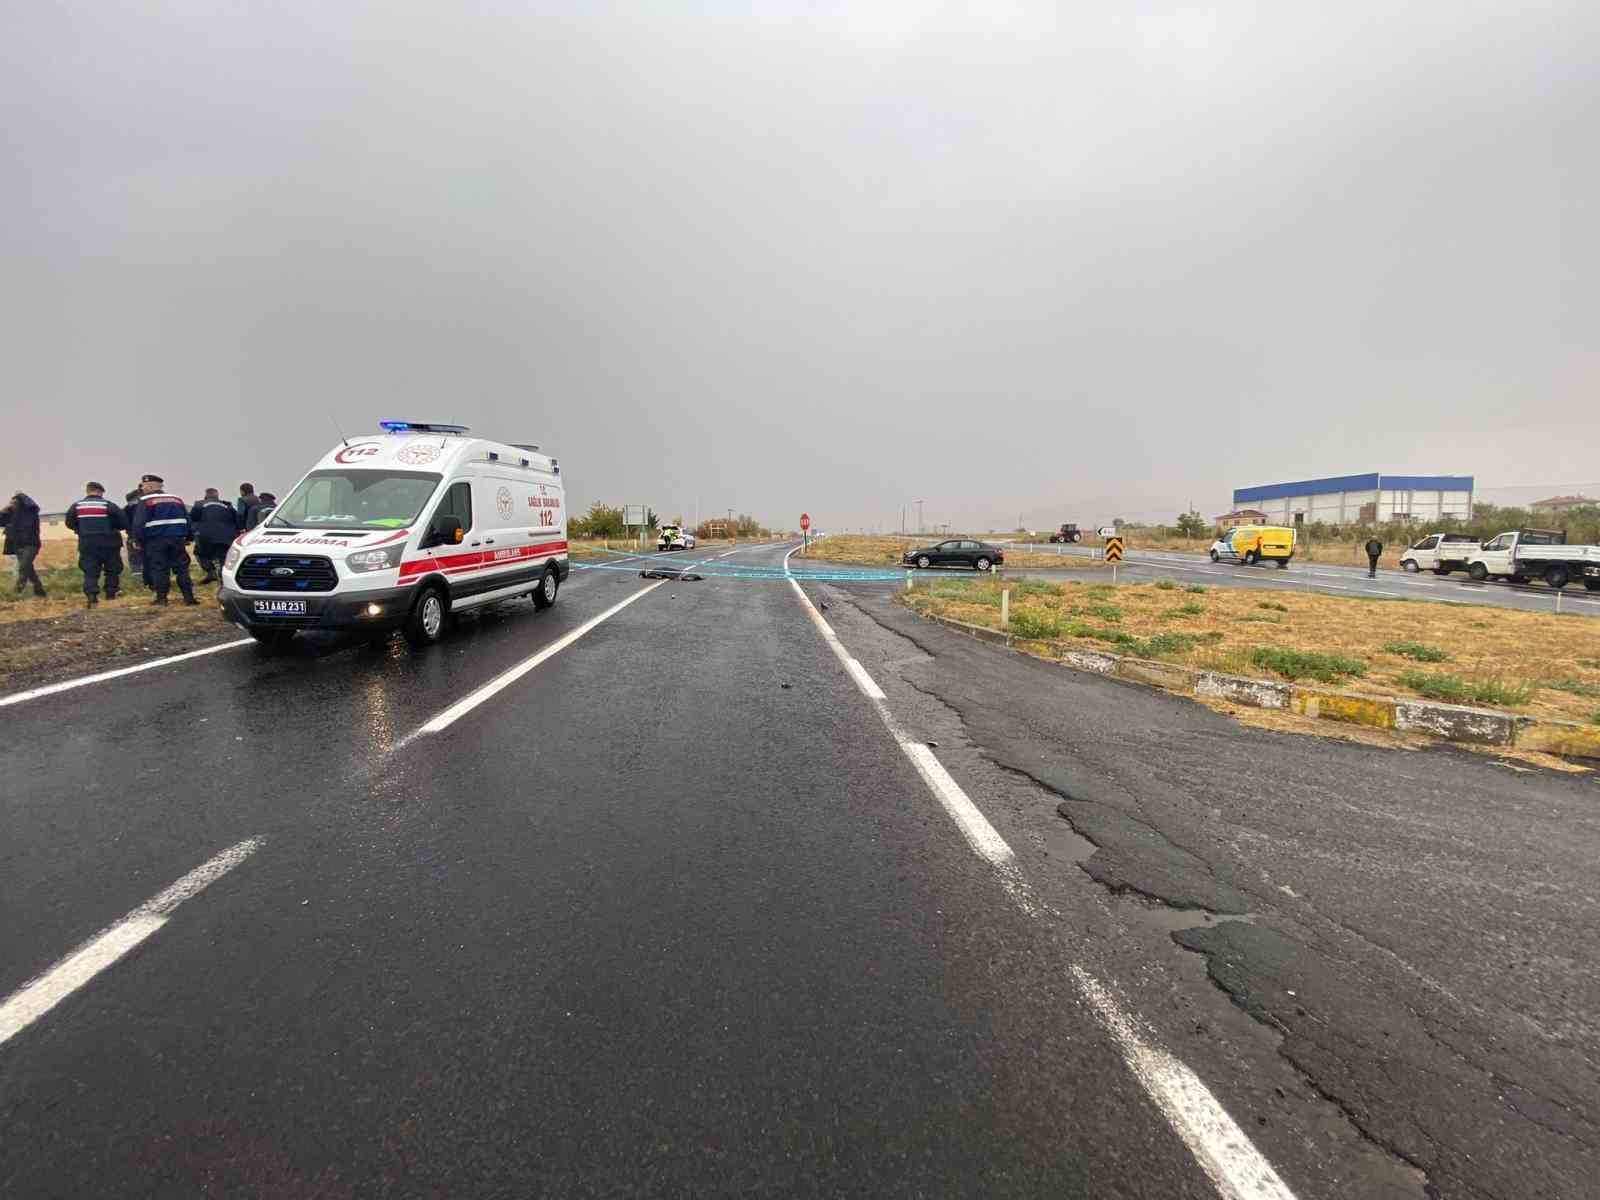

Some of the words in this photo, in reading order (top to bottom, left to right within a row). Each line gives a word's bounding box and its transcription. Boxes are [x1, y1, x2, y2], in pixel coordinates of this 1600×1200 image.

[347, 448, 378, 456] 112
[540, 511, 552, 526] 112
[260, 602, 269, 610] 51
[271, 602, 287, 610] AAR
[288, 602, 304, 611] 231
